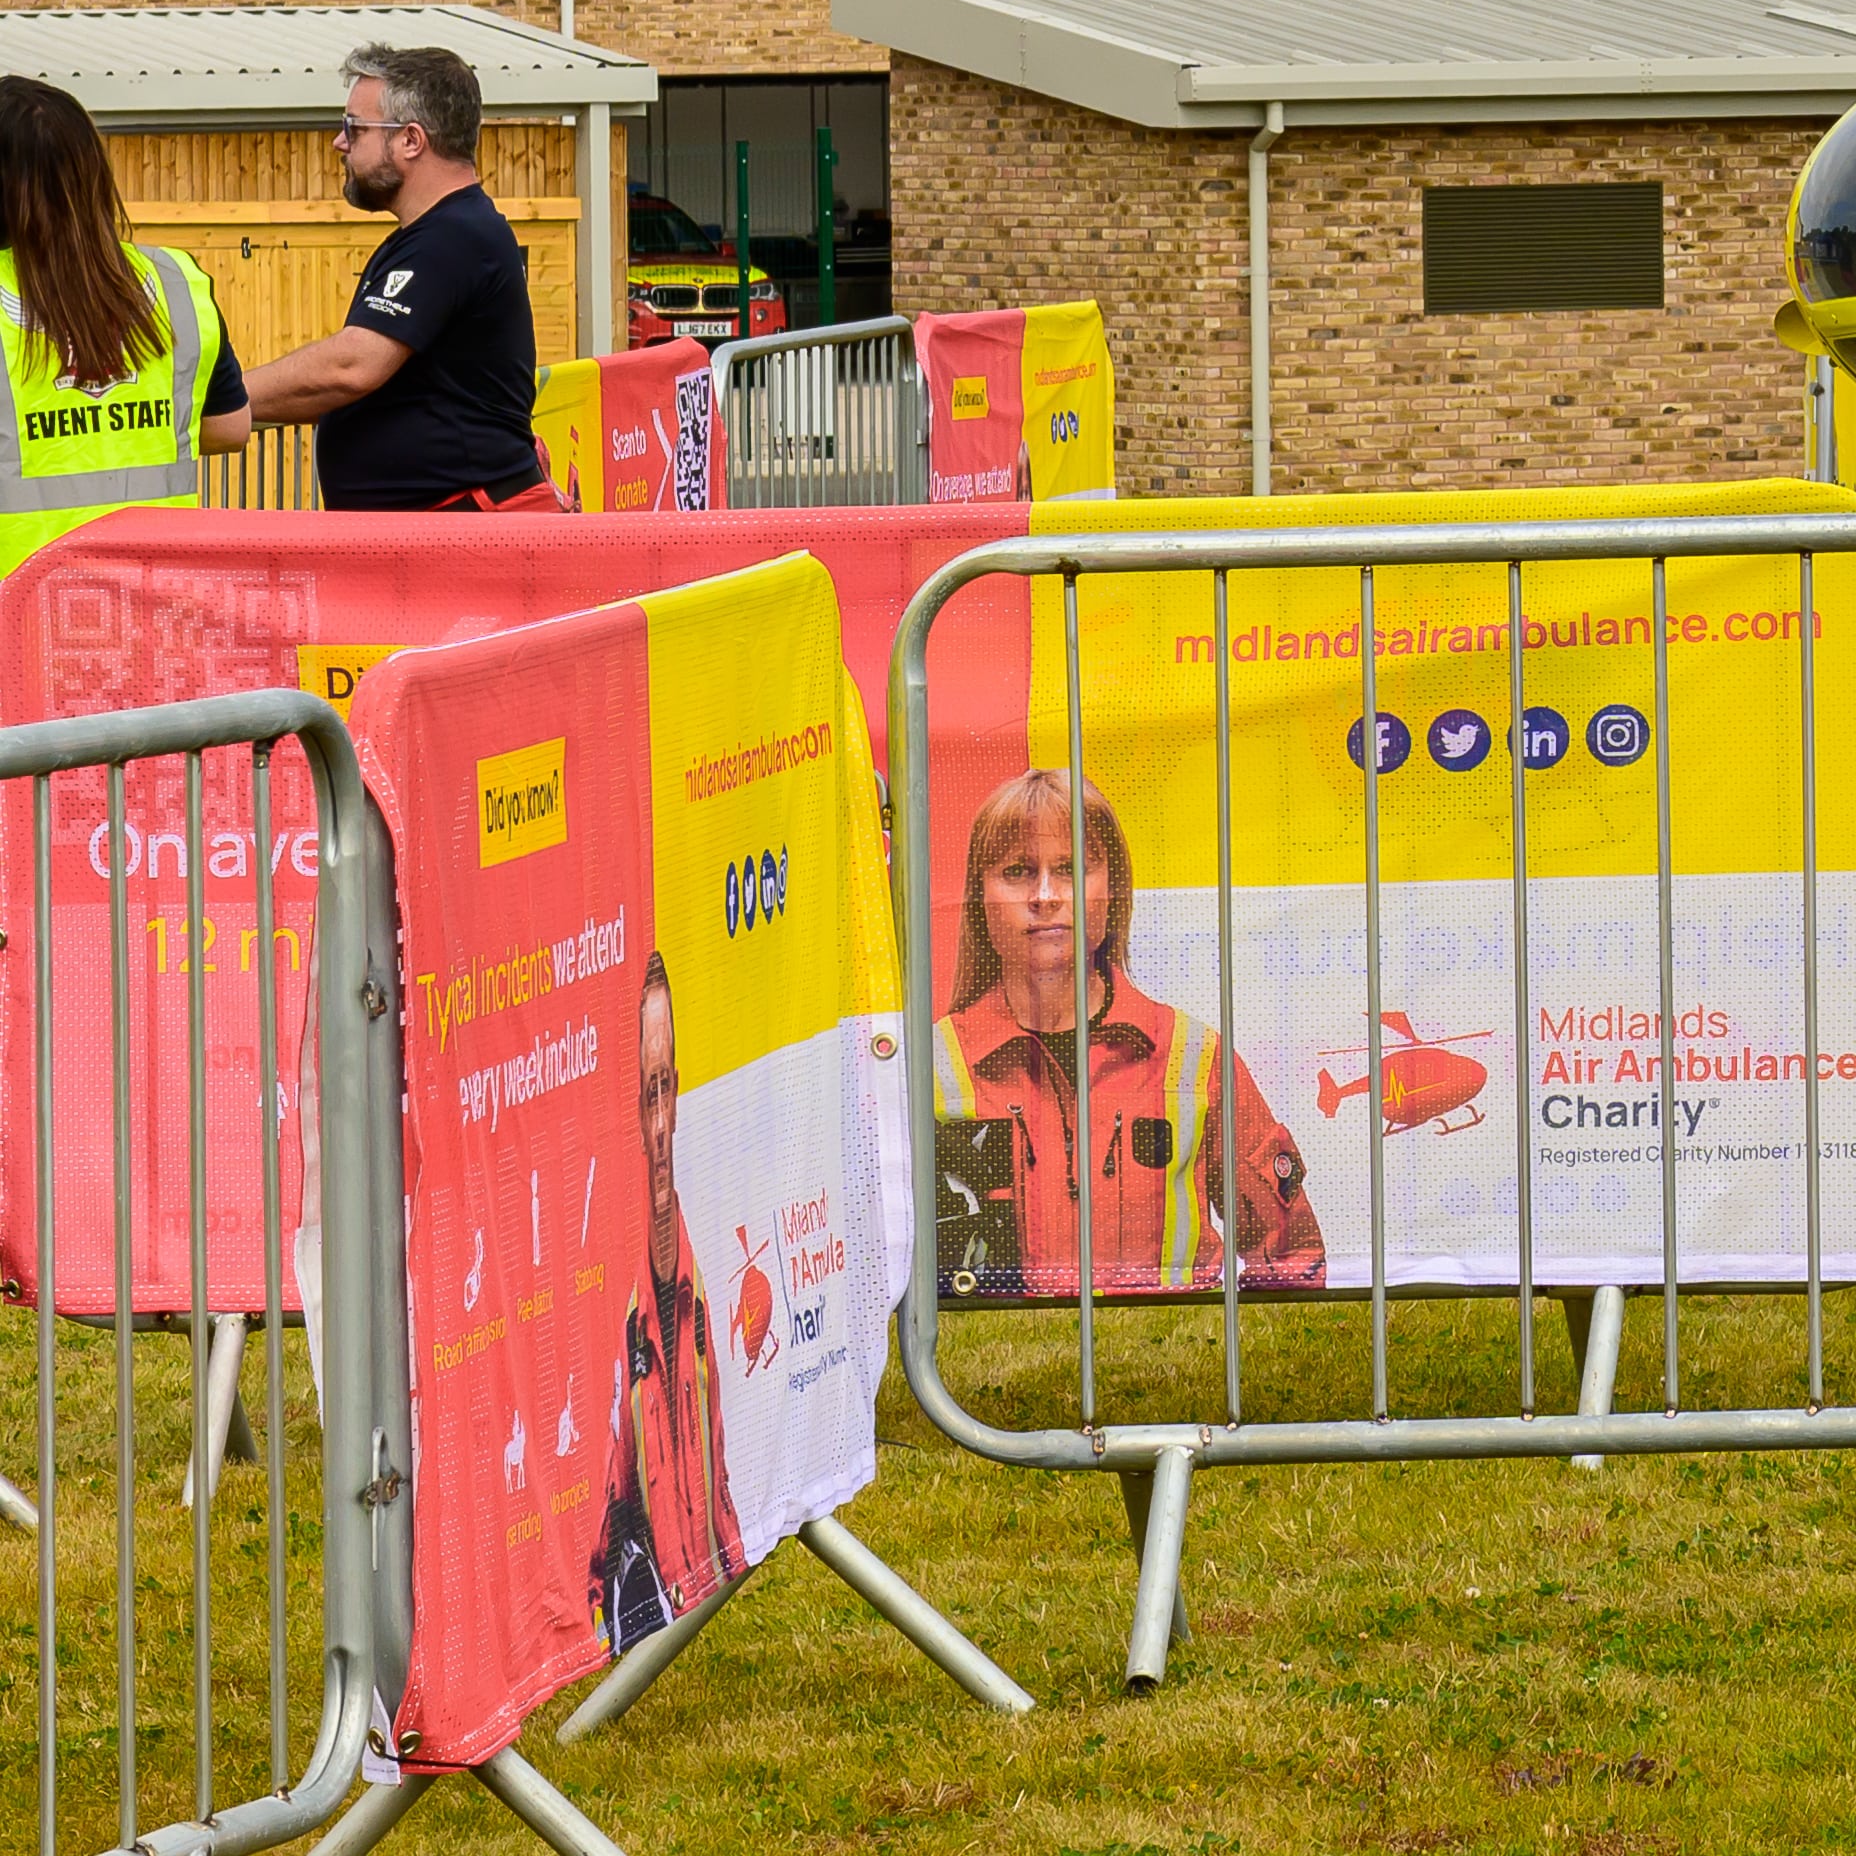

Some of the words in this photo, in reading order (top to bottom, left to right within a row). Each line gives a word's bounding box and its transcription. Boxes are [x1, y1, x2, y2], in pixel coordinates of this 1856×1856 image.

[25, 405, 102, 441] EVENT
[613, 428, 635, 461] Scan
[635, 425, 646, 456] to
[615, 475, 648, 511] donate
[1175, 611, 1823, 664] mdlandsairambulance.com
[485, 786, 505, 834] Did
[526, 769, 560, 828] know?
[480, 939, 553, 1017] incidents
[553, 938, 575, 991] we
[576, 904, 625, 983] attend
[503, 1036, 545, 1109] week
[545, 1014, 599, 1092] include
[1541, 1049, 1603, 1085] Air
[1540, 1145, 1641, 1168] Registered
[1716, 1142, 1790, 1161] Number
